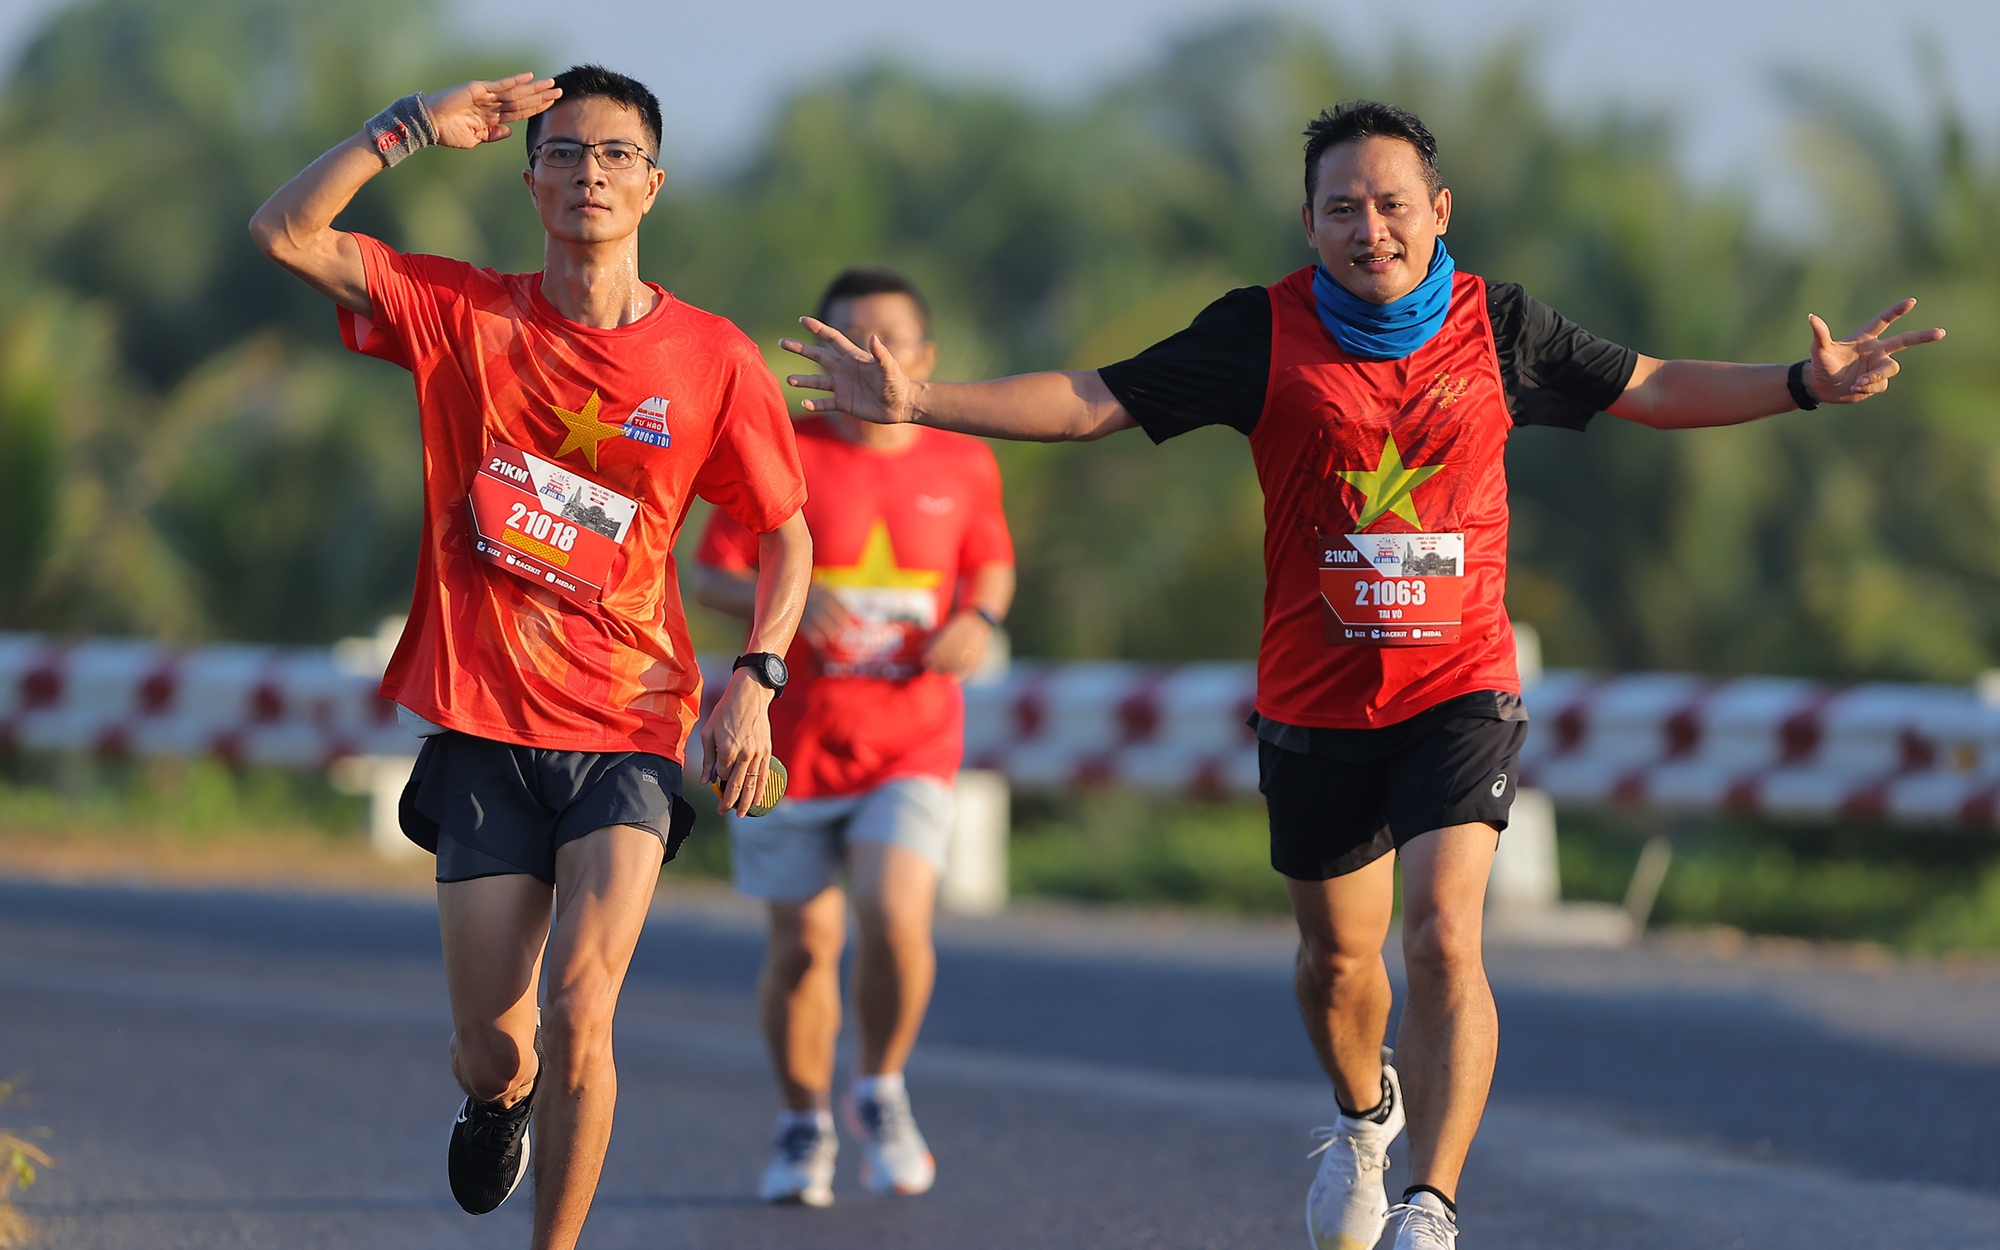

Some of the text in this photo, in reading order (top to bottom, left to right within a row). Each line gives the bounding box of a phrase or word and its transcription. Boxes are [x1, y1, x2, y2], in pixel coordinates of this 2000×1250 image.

[489, 457, 530, 484] 21KM
[505, 502, 578, 552] 21018
[1324, 549, 1359, 563] 21KM
[486, 547, 577, 593] SIZE RACEKIT MEDAL
[1355, 580, 1426, 606] 21063
[1422, 630, 1443, 638] MEDAL
